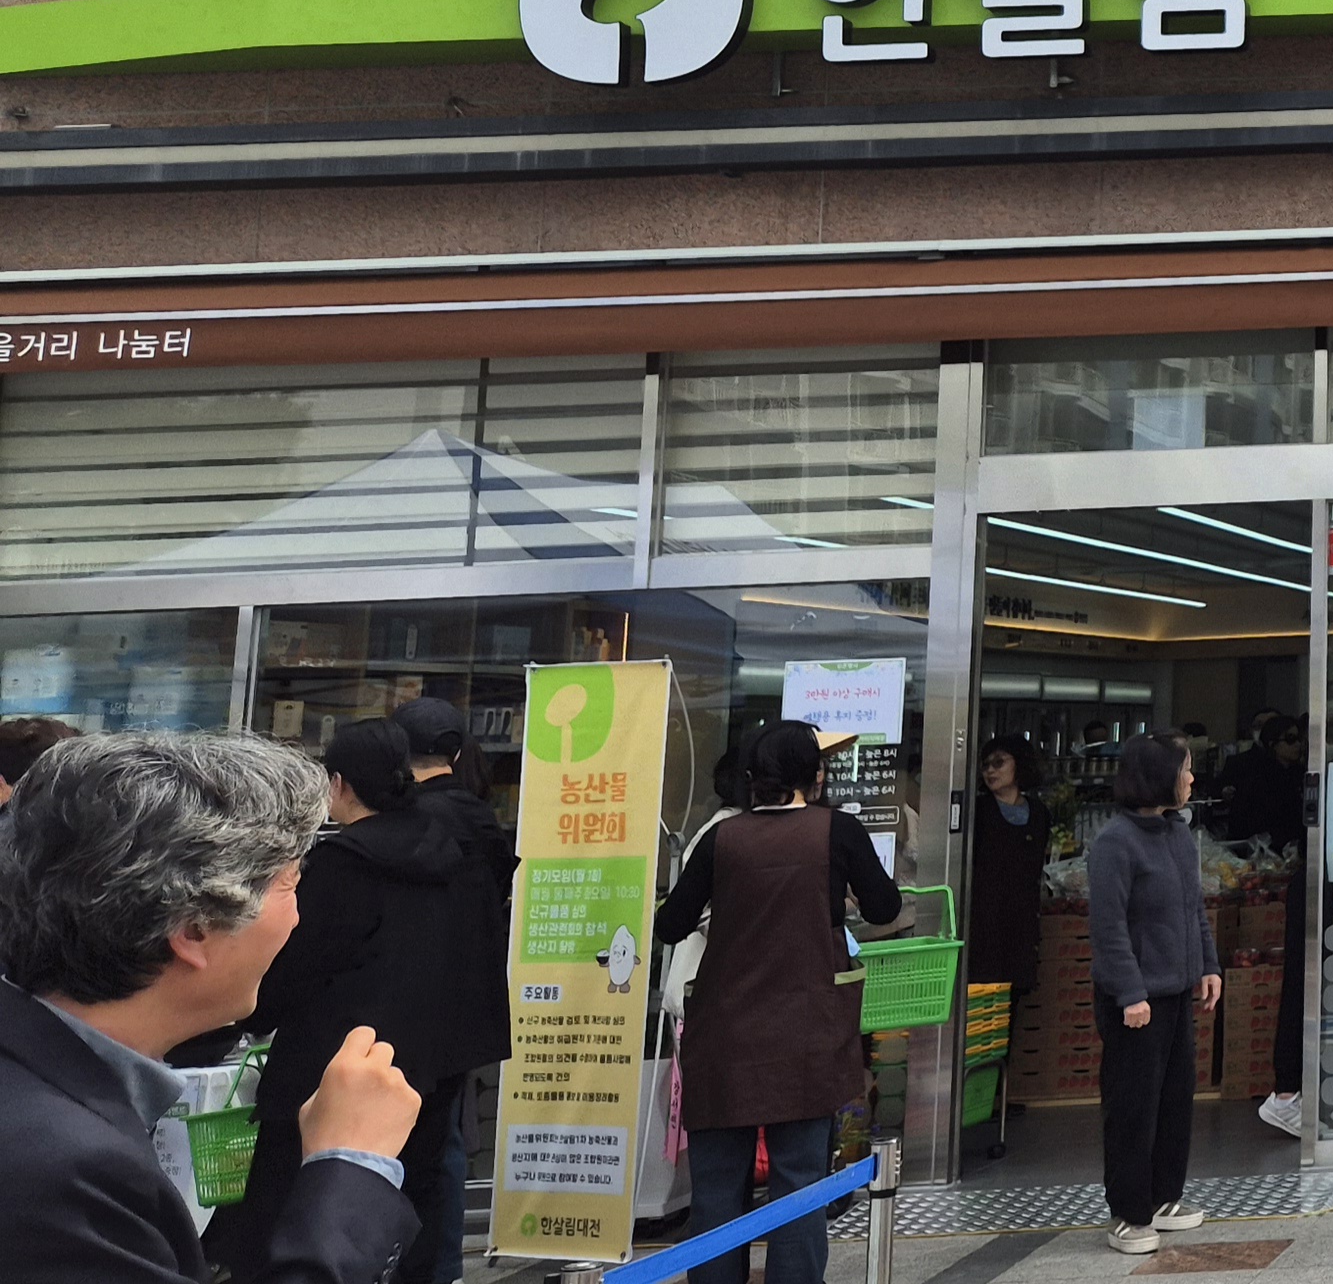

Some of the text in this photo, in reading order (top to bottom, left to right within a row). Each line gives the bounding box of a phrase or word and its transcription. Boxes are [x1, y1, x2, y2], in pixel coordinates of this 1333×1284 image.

[98, 328, 191, 360] 나눔터
[833, 688, 850, 700] 이상
[883, 748, 897, 758] 8시
[882, 770, 896, 780] 6시
[560, 771, 627, 805] 농산물
[836, 786, 853, 796] 10시
[881, 785, 895, 795] 6시
[557, 811, 627, 845] 위원회
[527, 941, 557, 955] 생산지
[524, 986, 559, 1000] 주요활동
[540, 1216, 601, 1238] 한살림대전
